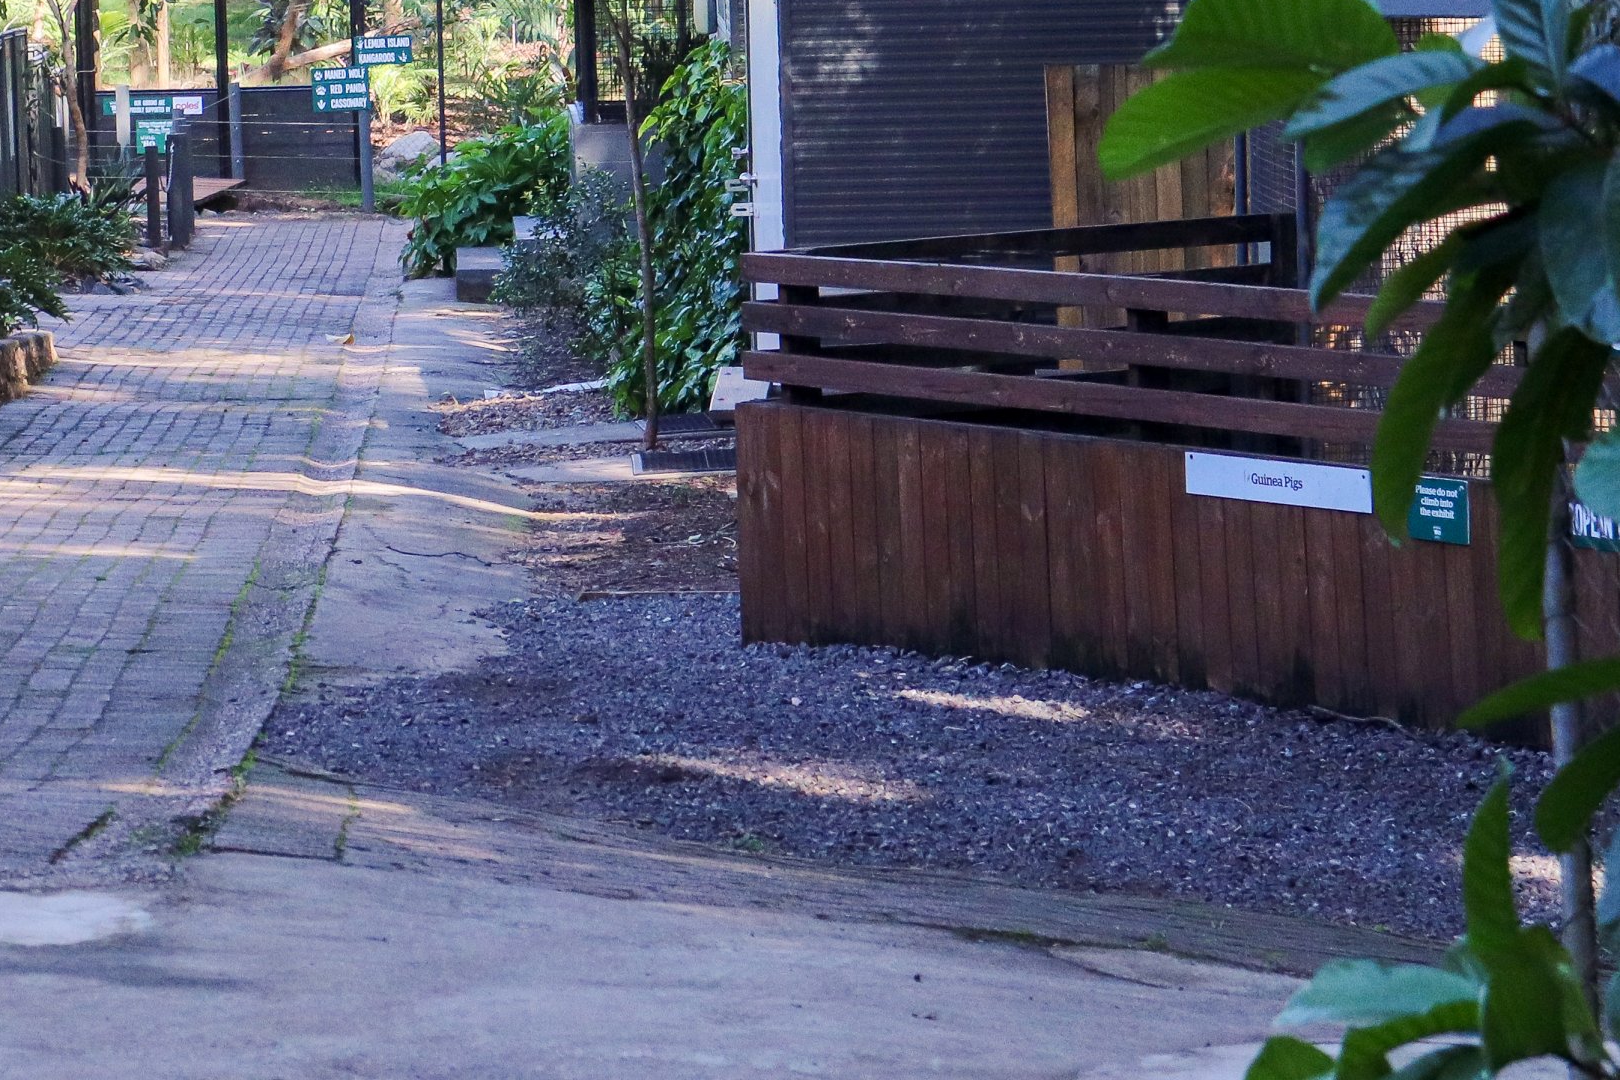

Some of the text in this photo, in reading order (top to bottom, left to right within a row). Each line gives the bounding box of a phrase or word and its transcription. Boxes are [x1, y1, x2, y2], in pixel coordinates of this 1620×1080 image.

[364, 37, 410, 49] LEMUR ISLAND
[358, 52, 395, 63] KANGAROOS
[324, 68, 365, 80] MANED WOLF
[330, 83, 367, 94] RED PANDA
[175, 101, 198, 110] coles
[331, 98, 367, 109] CASSOWARY
[1251, 473, 1303, 491] Guinea Pigs
[1415, 484, 1458, 498] Please do not
[1420, 496, 1454, 508] climb into
[1420, 507, 1455, 519] the exhibit
